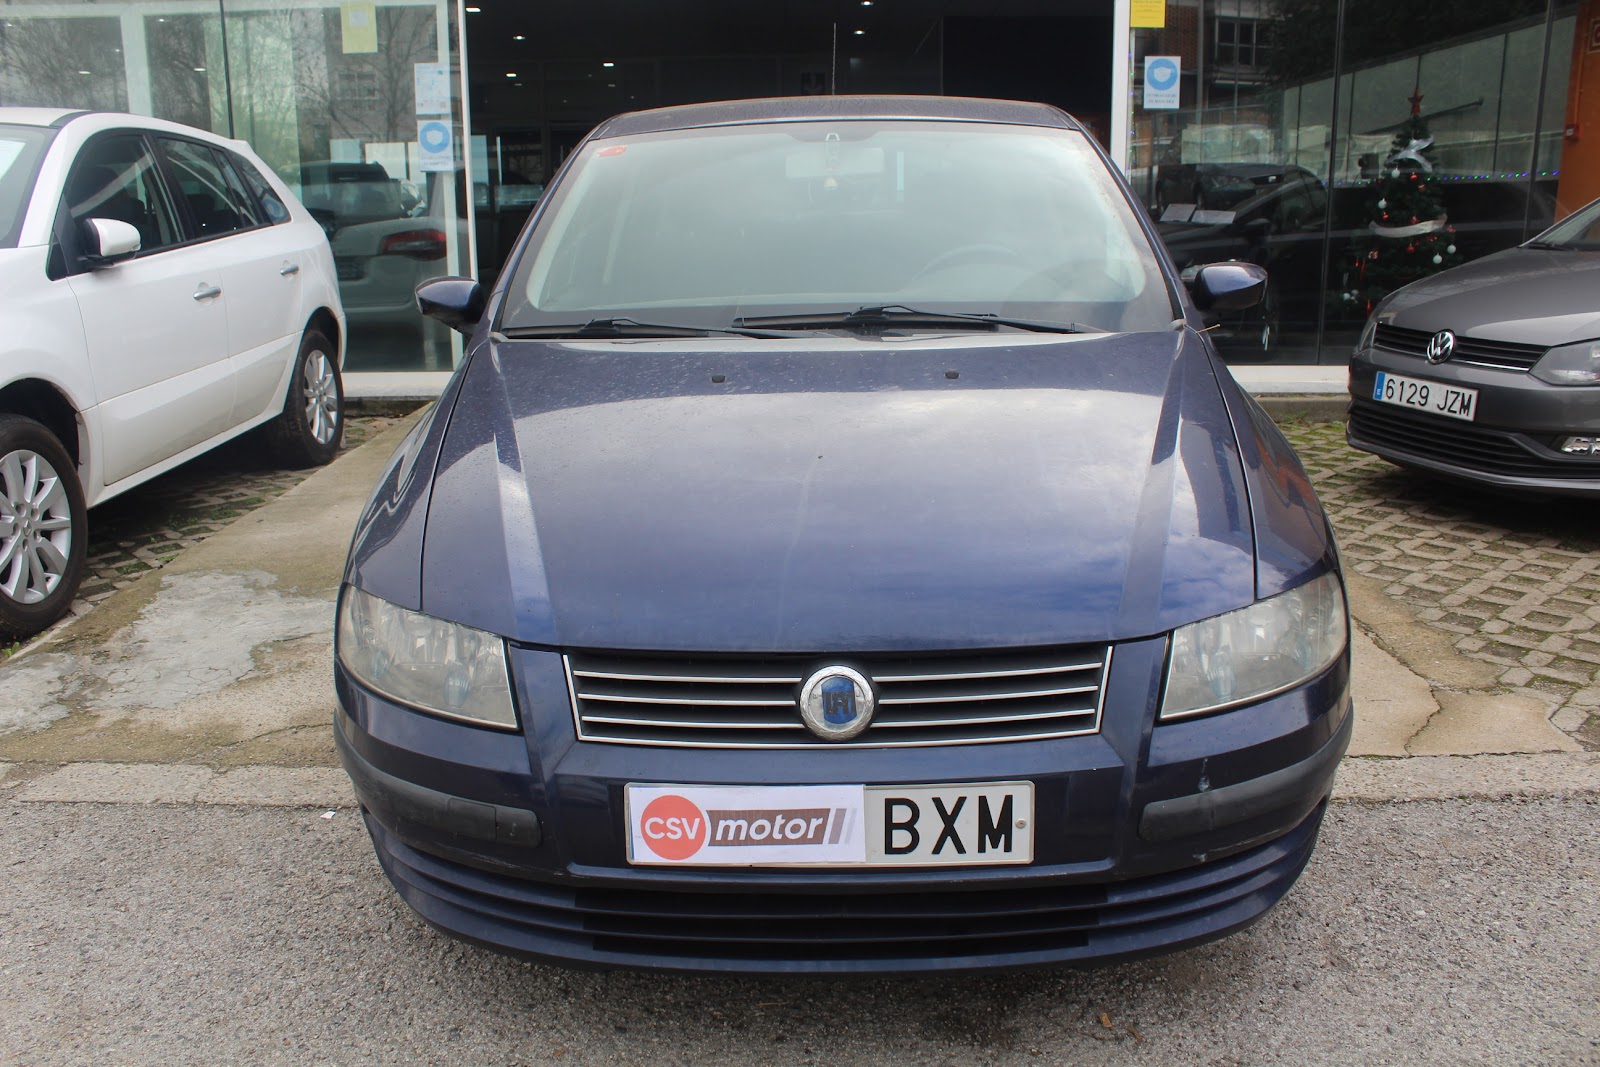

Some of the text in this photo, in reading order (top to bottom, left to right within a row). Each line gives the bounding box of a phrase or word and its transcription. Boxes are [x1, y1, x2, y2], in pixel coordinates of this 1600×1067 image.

[1385, 378, 1473, 417] 6129 JZM
[644, 813, 824, 842] CSV motor
[884, 794, 1014, 856] BXM
